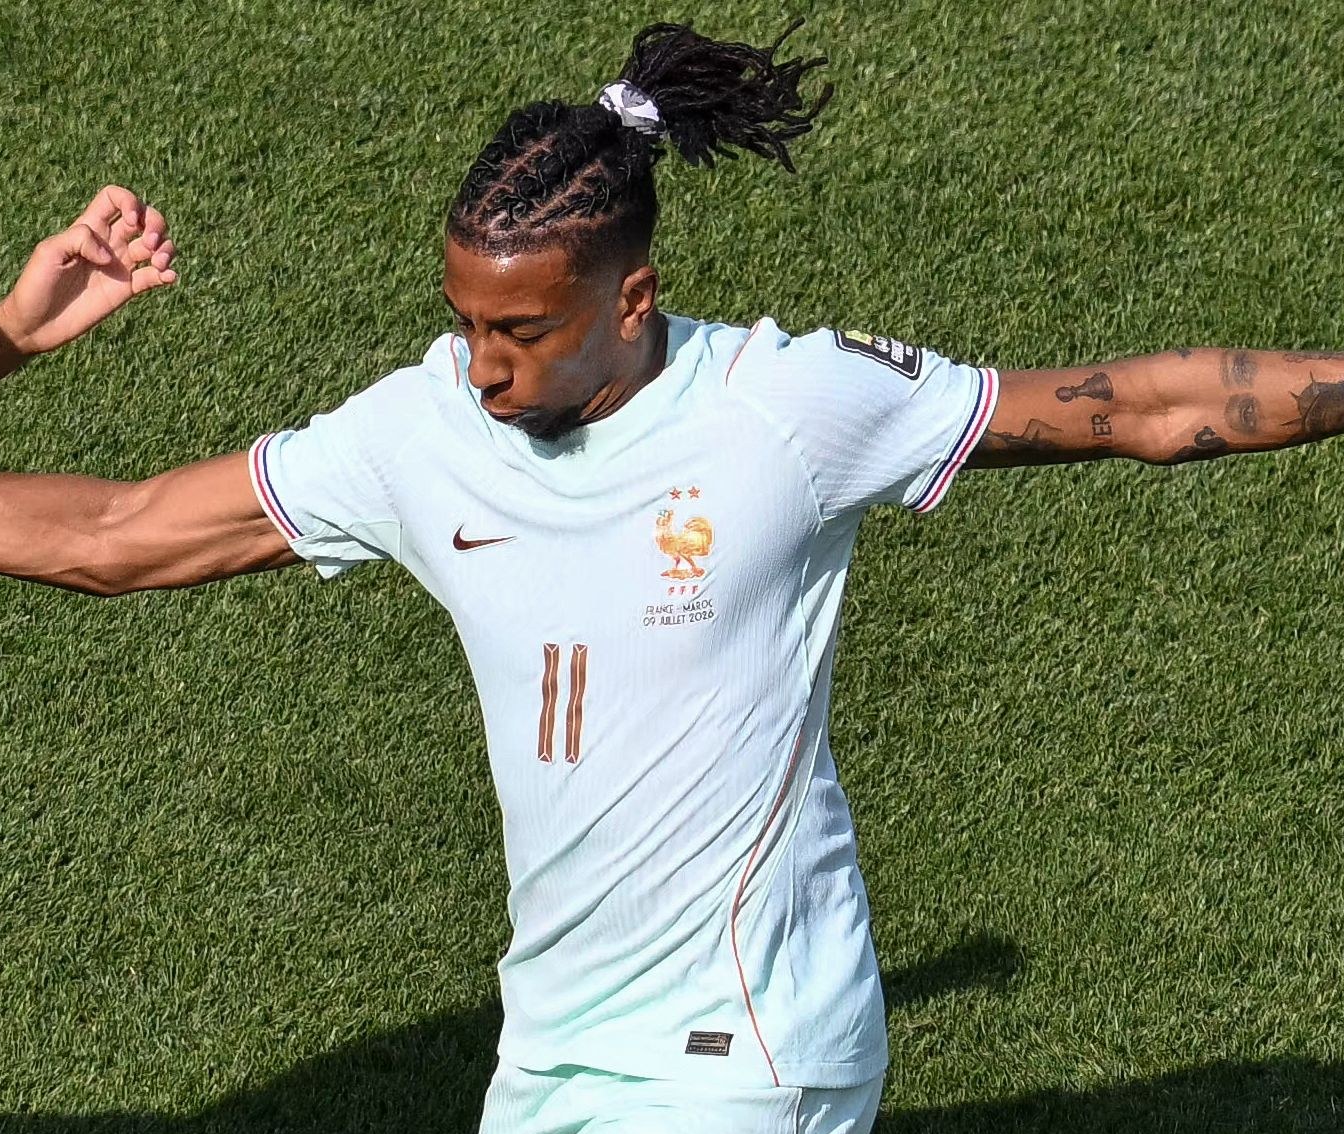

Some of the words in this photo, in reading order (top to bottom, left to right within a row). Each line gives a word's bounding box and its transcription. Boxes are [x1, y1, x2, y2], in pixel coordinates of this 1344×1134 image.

[642, 616, 656, 627] 09
[688, 610, 715, 623] 2026
[536, 642, 589, 764] 11
